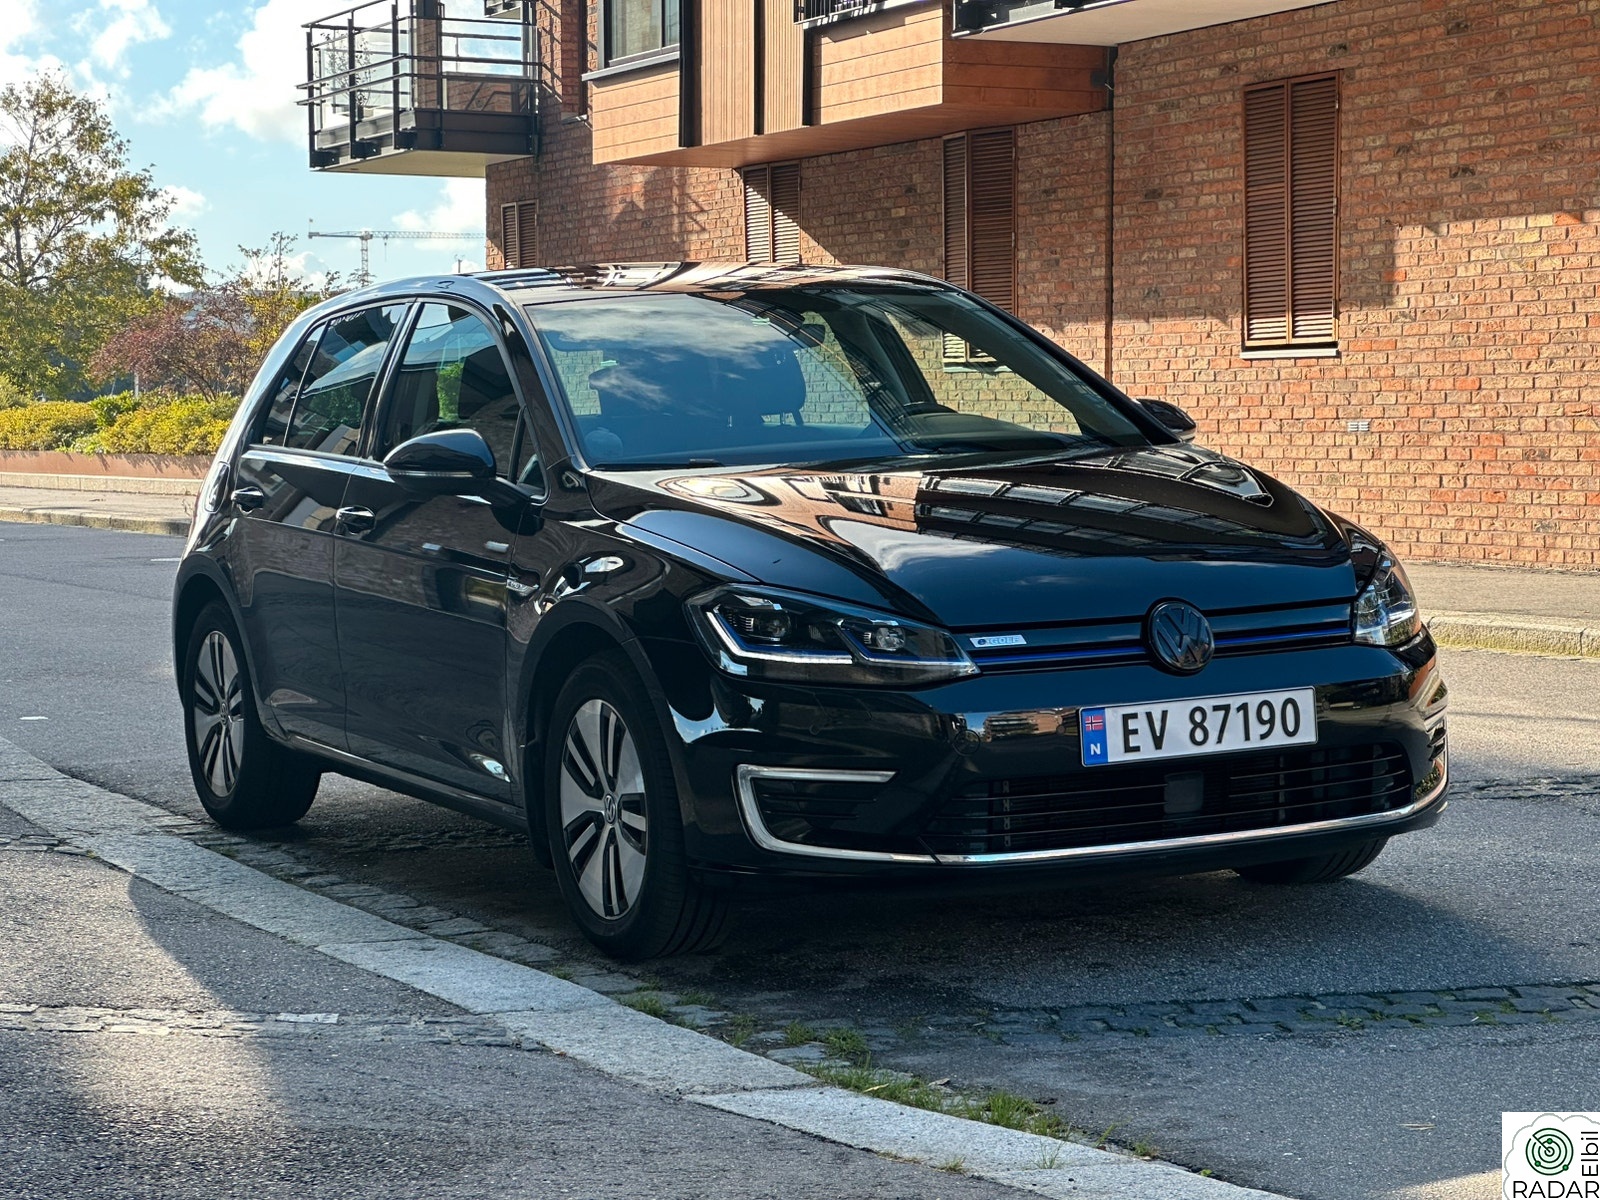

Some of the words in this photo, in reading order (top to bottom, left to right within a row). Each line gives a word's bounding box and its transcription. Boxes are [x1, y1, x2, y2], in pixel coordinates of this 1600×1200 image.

[1122, 710, 1168, 754] EV
[1188, 697, 1300, 746] 87190
[1090, 743, 1101, 756] N
